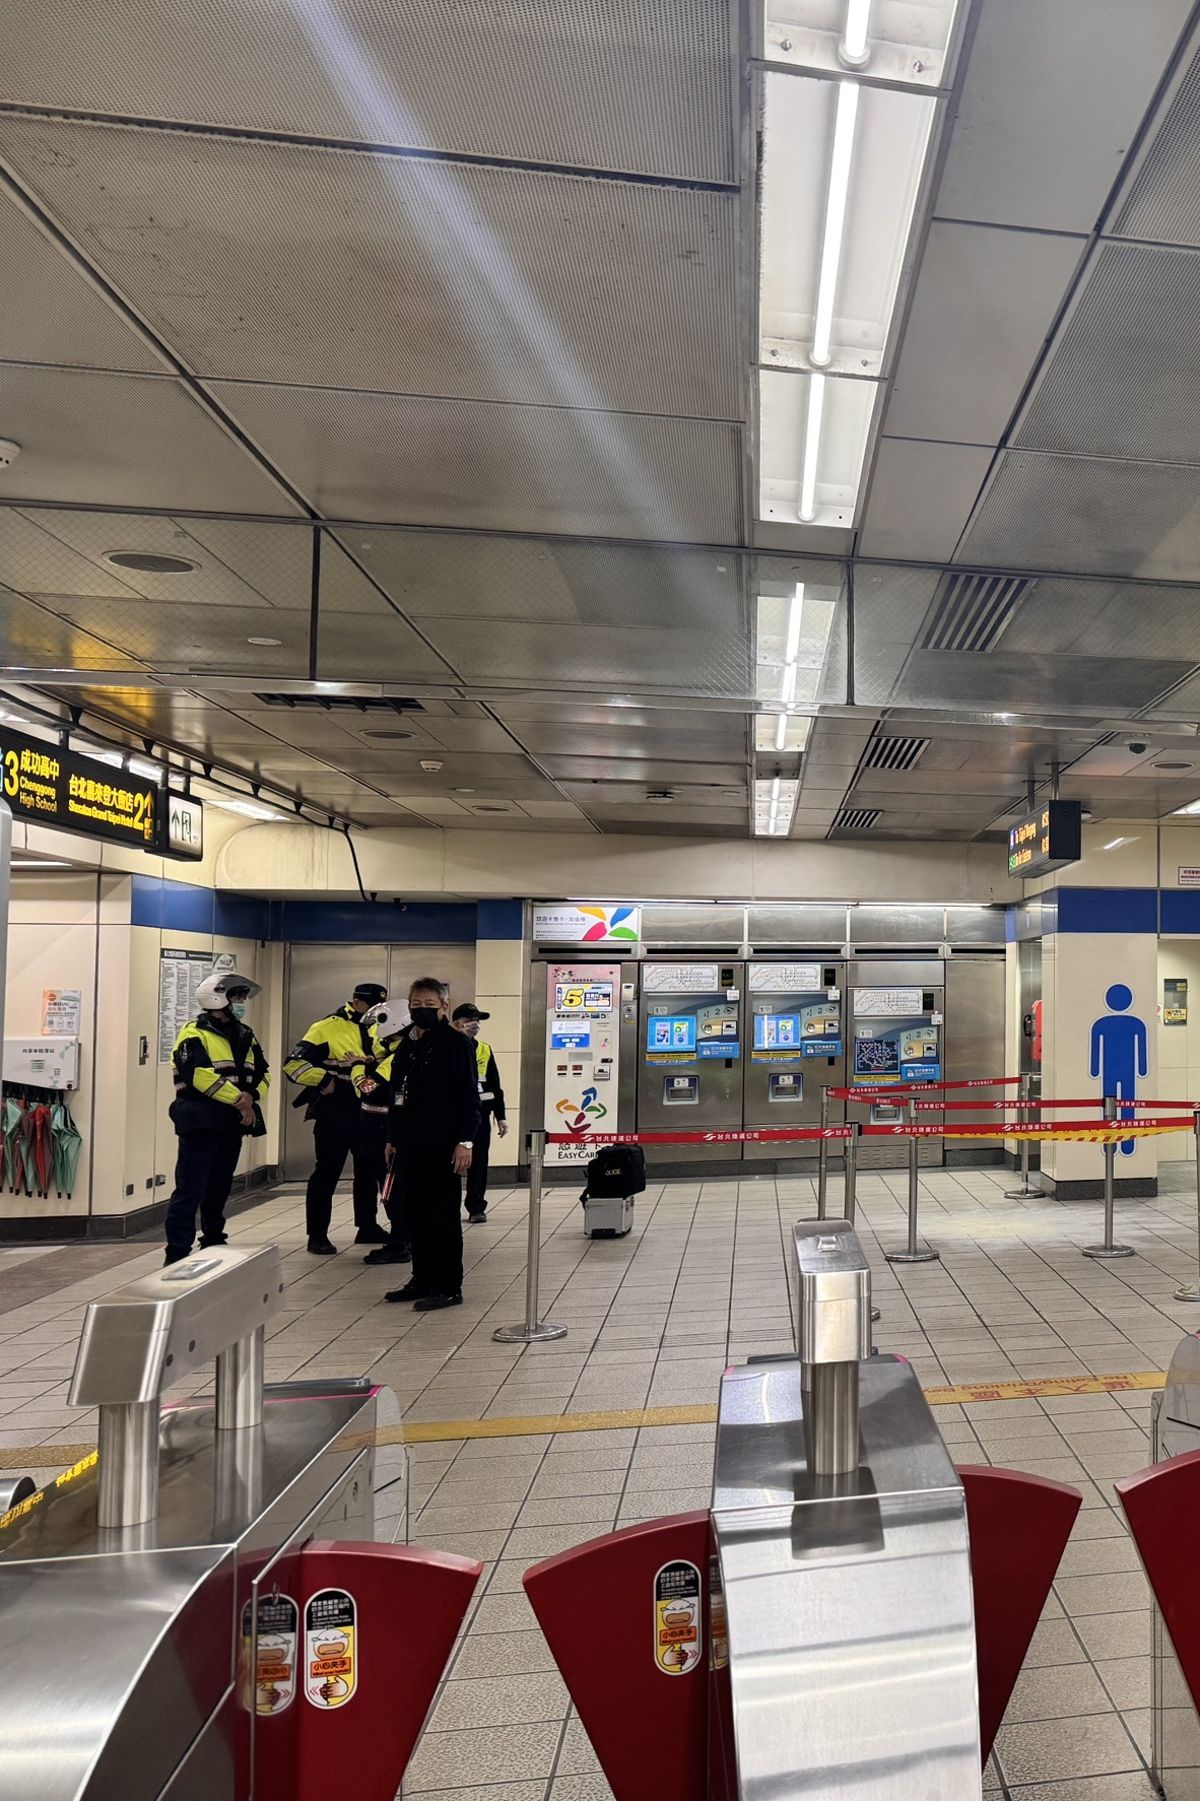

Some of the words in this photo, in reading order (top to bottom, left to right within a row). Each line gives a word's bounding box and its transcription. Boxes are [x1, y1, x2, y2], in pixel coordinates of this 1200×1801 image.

[4, 750, 19, 796] 3
[20, 748, 60, 781] 成功高中
[20, 776, 56, 800] Chenggong
[20, 791, 35, 808] High
[35, 796, 57, 812] School
[133, 792, 144, 831] 2
[562, 988, 584, 1007] 5
